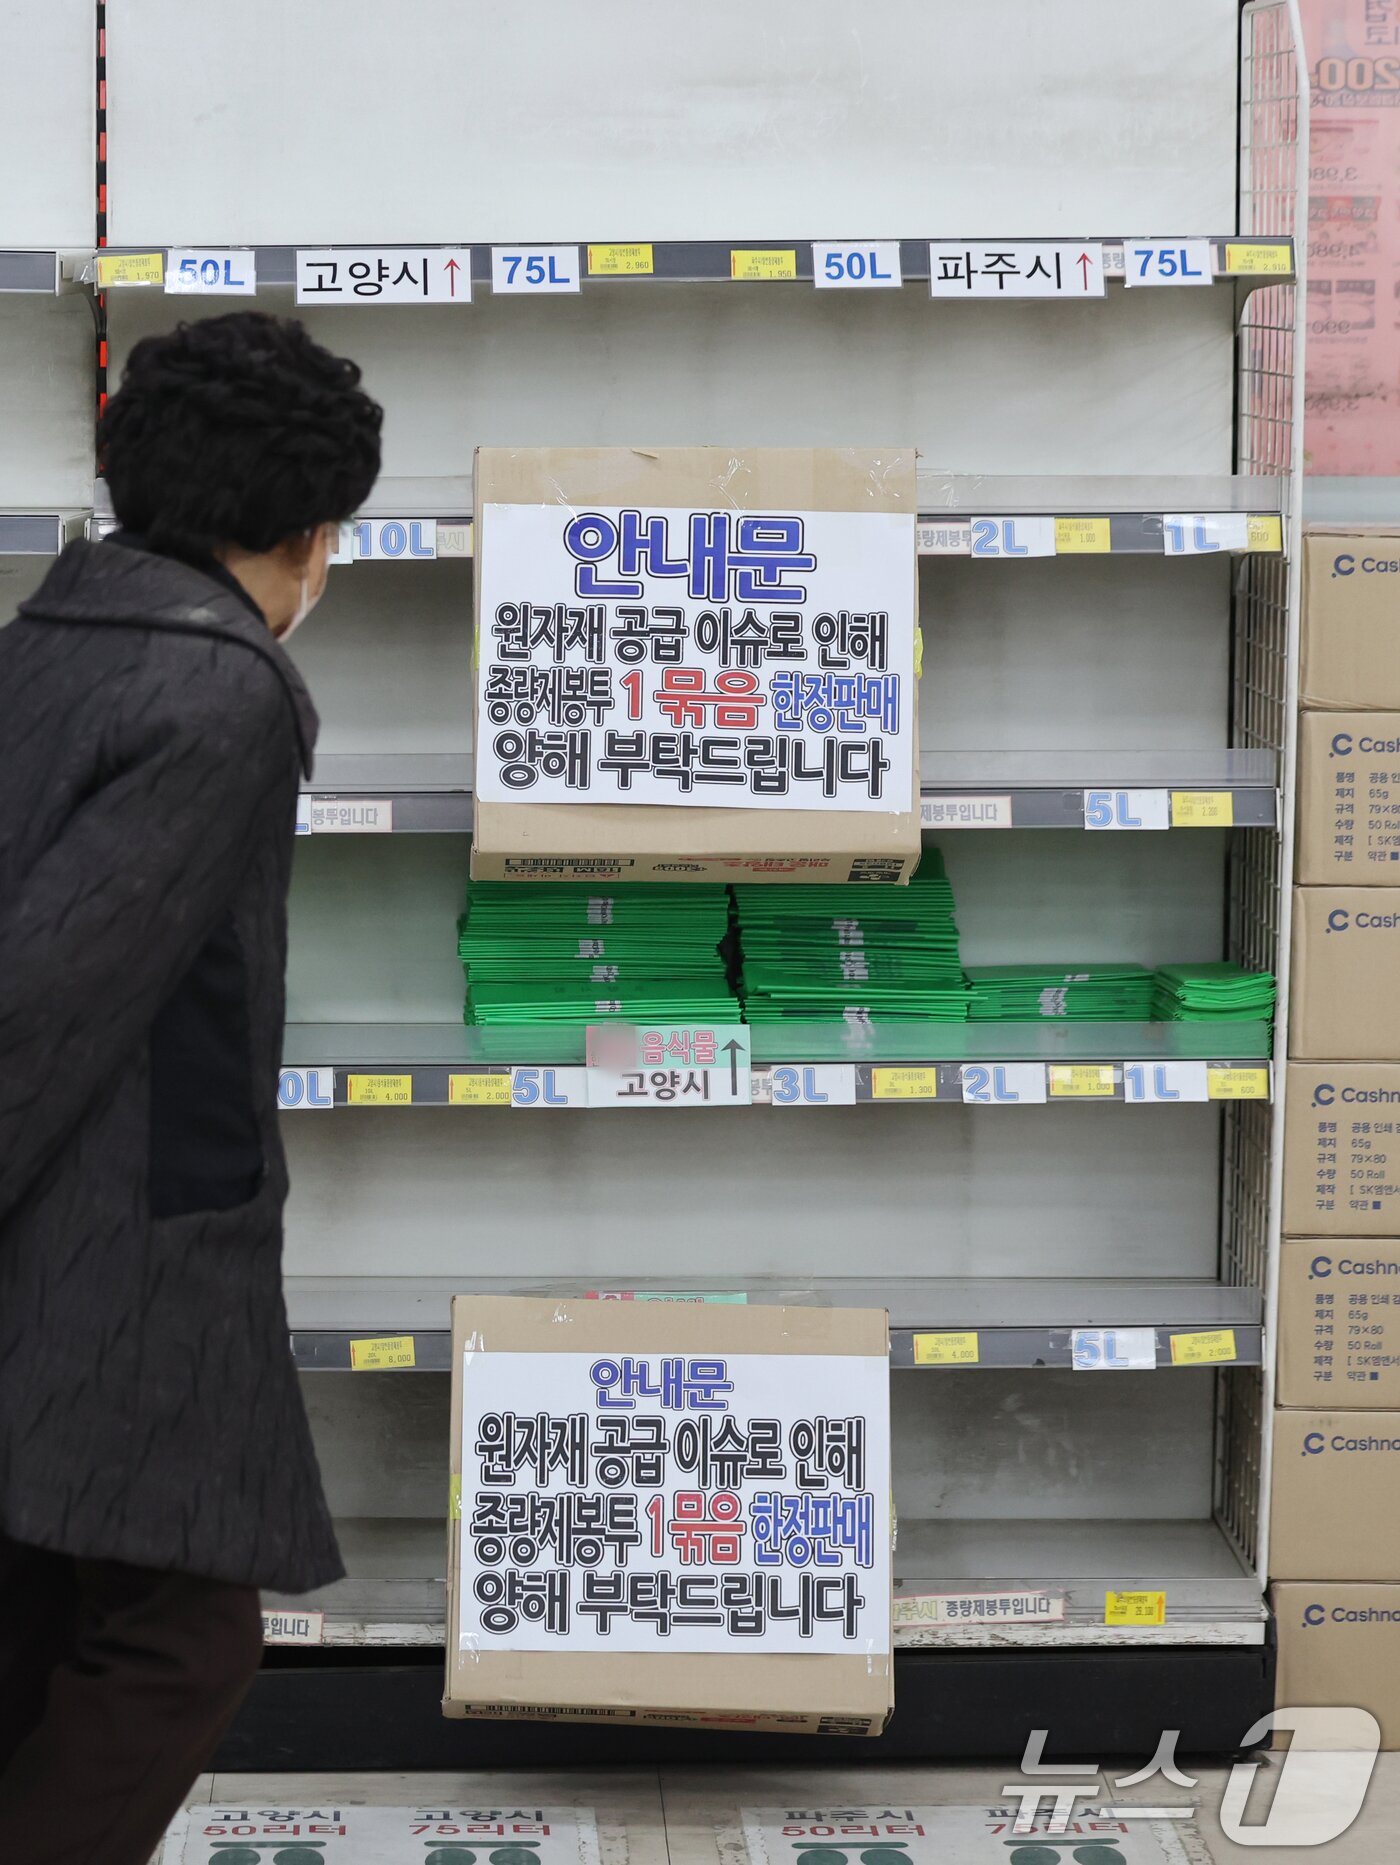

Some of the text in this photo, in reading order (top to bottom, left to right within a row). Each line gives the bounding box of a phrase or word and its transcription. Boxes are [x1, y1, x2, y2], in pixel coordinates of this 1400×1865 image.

[178, 259, 244, 286] 50L
[303, 258, 428, 296] 고양시
[502, 256, 570, 284] 75L
[825, 252, 891, 280] 50L
[937, 251, 1062, 290] 파주시
[1134, 250, 1202, 277] 75L
[353, 522, 434, 557] 10L
[972, 520, 1028, 555] 2L
[1165, 516, 1220, 552] 1L
[563, 509, 817, 604] 안내문
[1361, 557, 1400, 573] Cas
[491, 602, 889, 671] 원자재 공급 이슈로 인해
[485, 665, 900, 735] 종량제봉투 1 묶음 한정판매
[492, 728, 890, 799] 양해 부탁드립니다
[1368, 788, 1389, 799] 65g
[313, 808, 378, 826] 봉투입니다
[1085, 792, 1142, 827] 5L
[1368, 820, 1382, 830] 50
[640, 1030, 718, 1065] 음식물
[512, 1069, 568, 1105] 5L
[617, 1070, 709, 1101] 고양시
[773, 1067, 828, 1103] 3L
[963, 1066, 1019, 1101] 2L
[1125, 1064, 1180, 1100] 1L
[1351, 1138, 1371, 1149] 65g
[1350, 1169, 1364, 1179] 50
[1338, 1259, 1400, 1275] Cashn
[1348, 1310, 1368, 1321] 65g
[1073, 1331, 1129, 1368] 5L
[1347, 1341, 1361, 1350] 50
[589, 1357, 735, 1411] 안내문
[474, 1411, 866, 1491] 원자재 공급 이슈로 인해
[470, 1490, 874, 1569] 종량제봉투 1 묶음 한정판매
[473, 1568, 865, 1639] 양해 부탁드립니다
[946, 1597, 1050, 1618] 종량제봉투입니다
[202, 1824, 347, 1836] 50리터
[210, 1809, 342, 1822] 고양시
[408, 1824, 551, 1836] 75리터
[414, 1809, 544, 1822] 고양시
[781, 1823, 926, 1837] 50리터
[784, 1809, 914, 1821] 파주시
